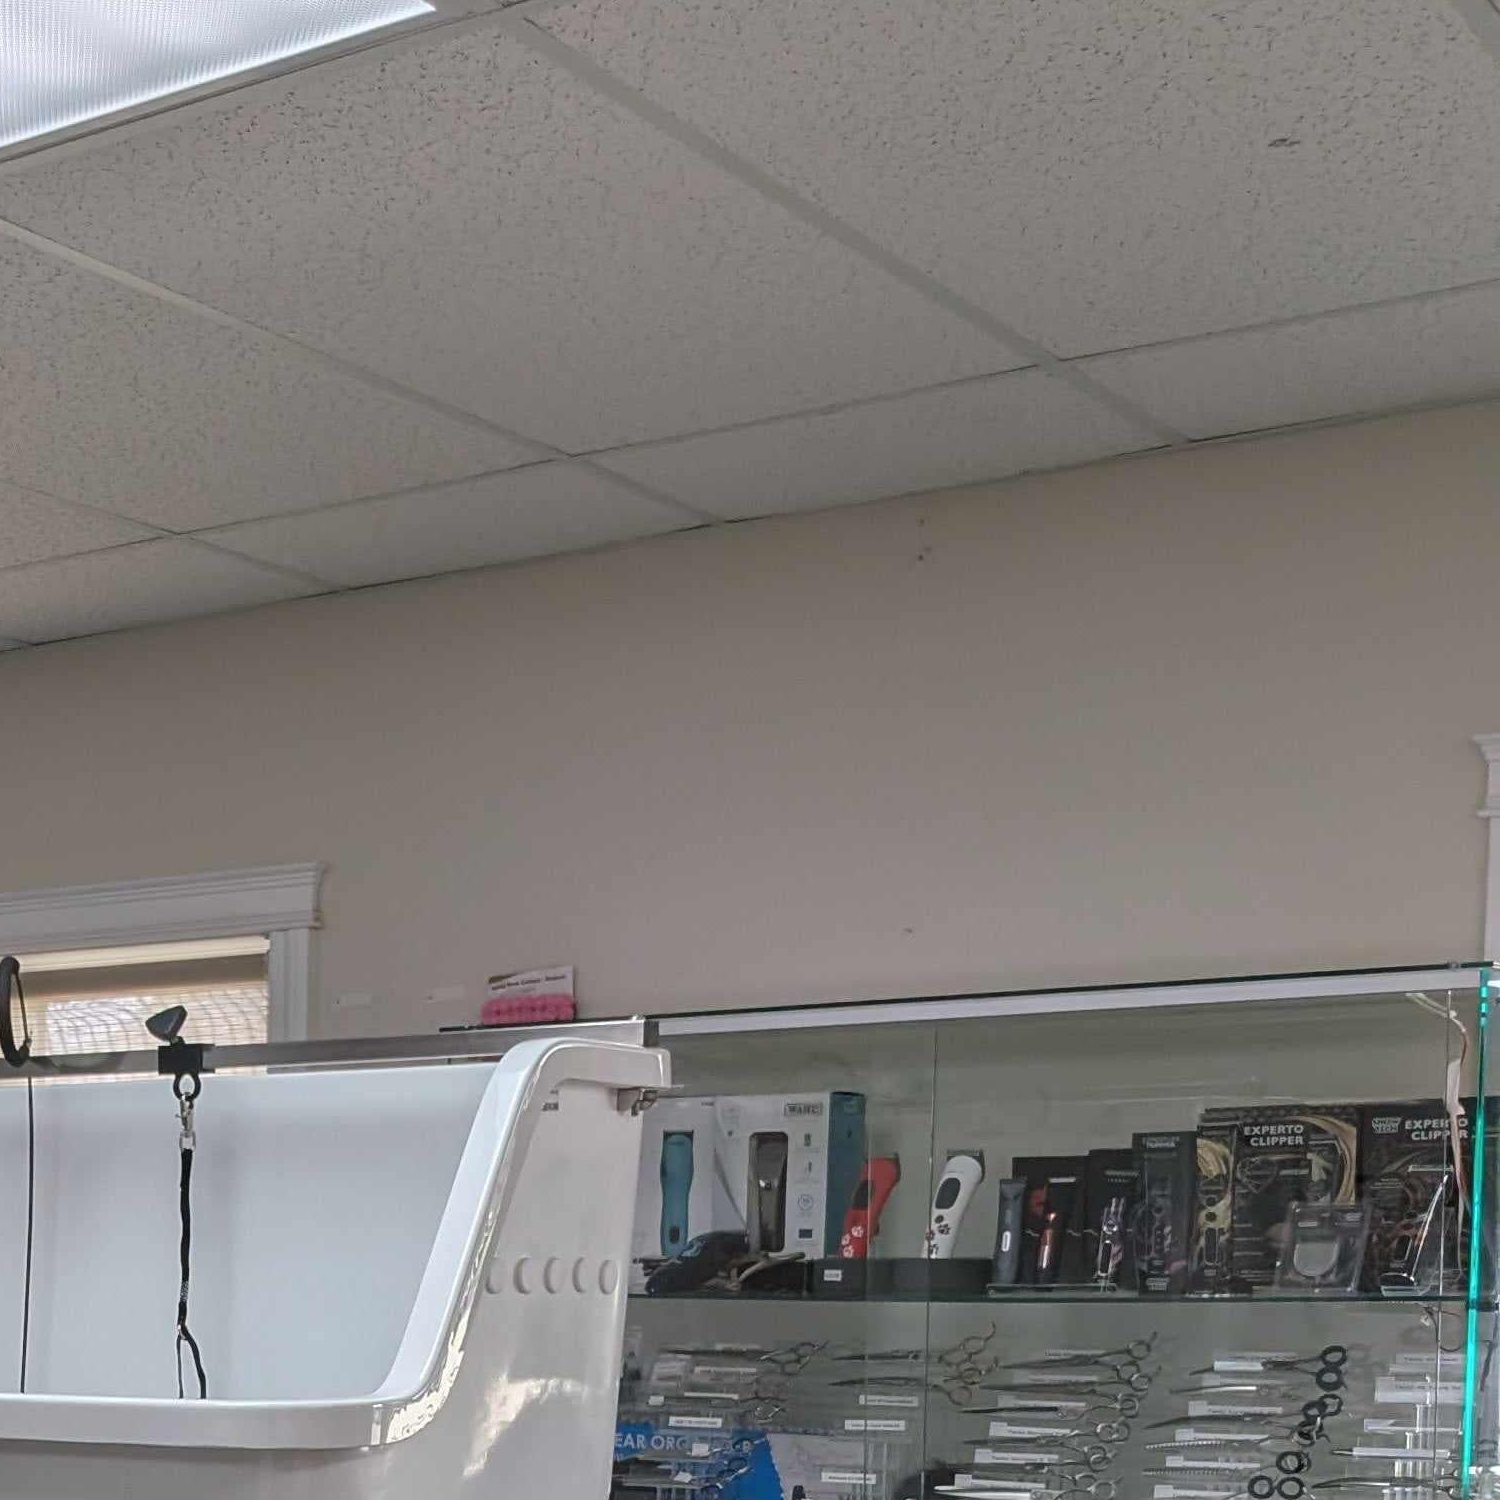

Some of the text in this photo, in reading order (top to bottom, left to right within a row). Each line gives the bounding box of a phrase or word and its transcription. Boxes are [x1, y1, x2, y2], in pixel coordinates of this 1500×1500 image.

[1405, 1118, 1468, 1129] EXPERO
[1243, 1124, 1304, 1136] EXPERTO
[1411, 1130, 1468, 1141] CLIPPR
[1250, 1136, 1304, 1146] CLIPPER
